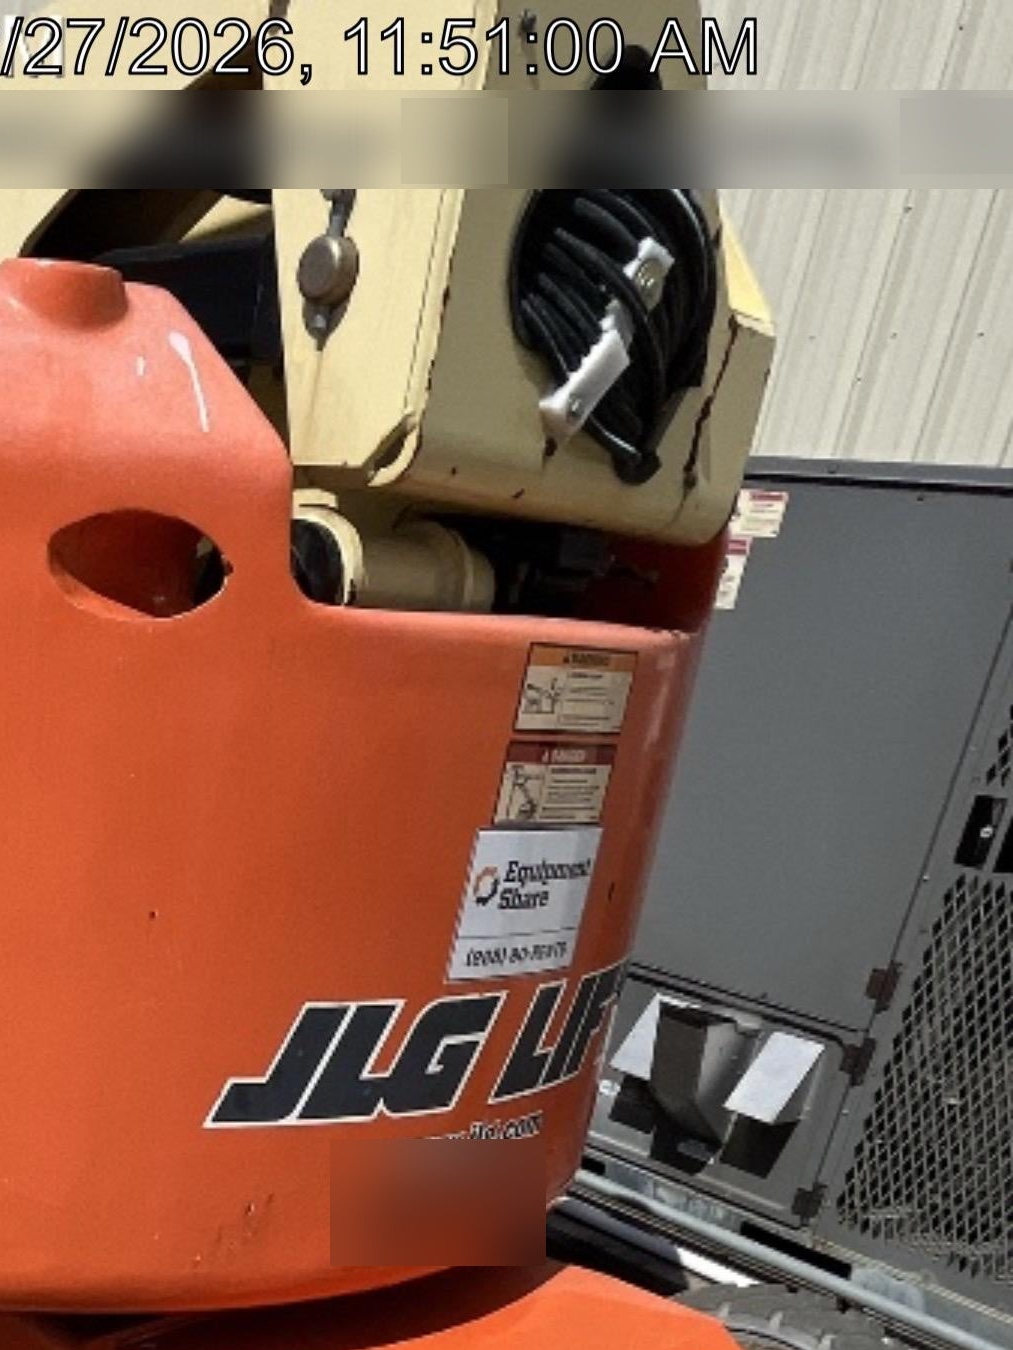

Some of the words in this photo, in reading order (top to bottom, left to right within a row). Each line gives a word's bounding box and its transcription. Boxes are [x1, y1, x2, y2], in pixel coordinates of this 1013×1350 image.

[498, 887, 549, 910] Share
[202, 989, 509, 1128] JLG
[487, 957, 627, 1105] LIF
